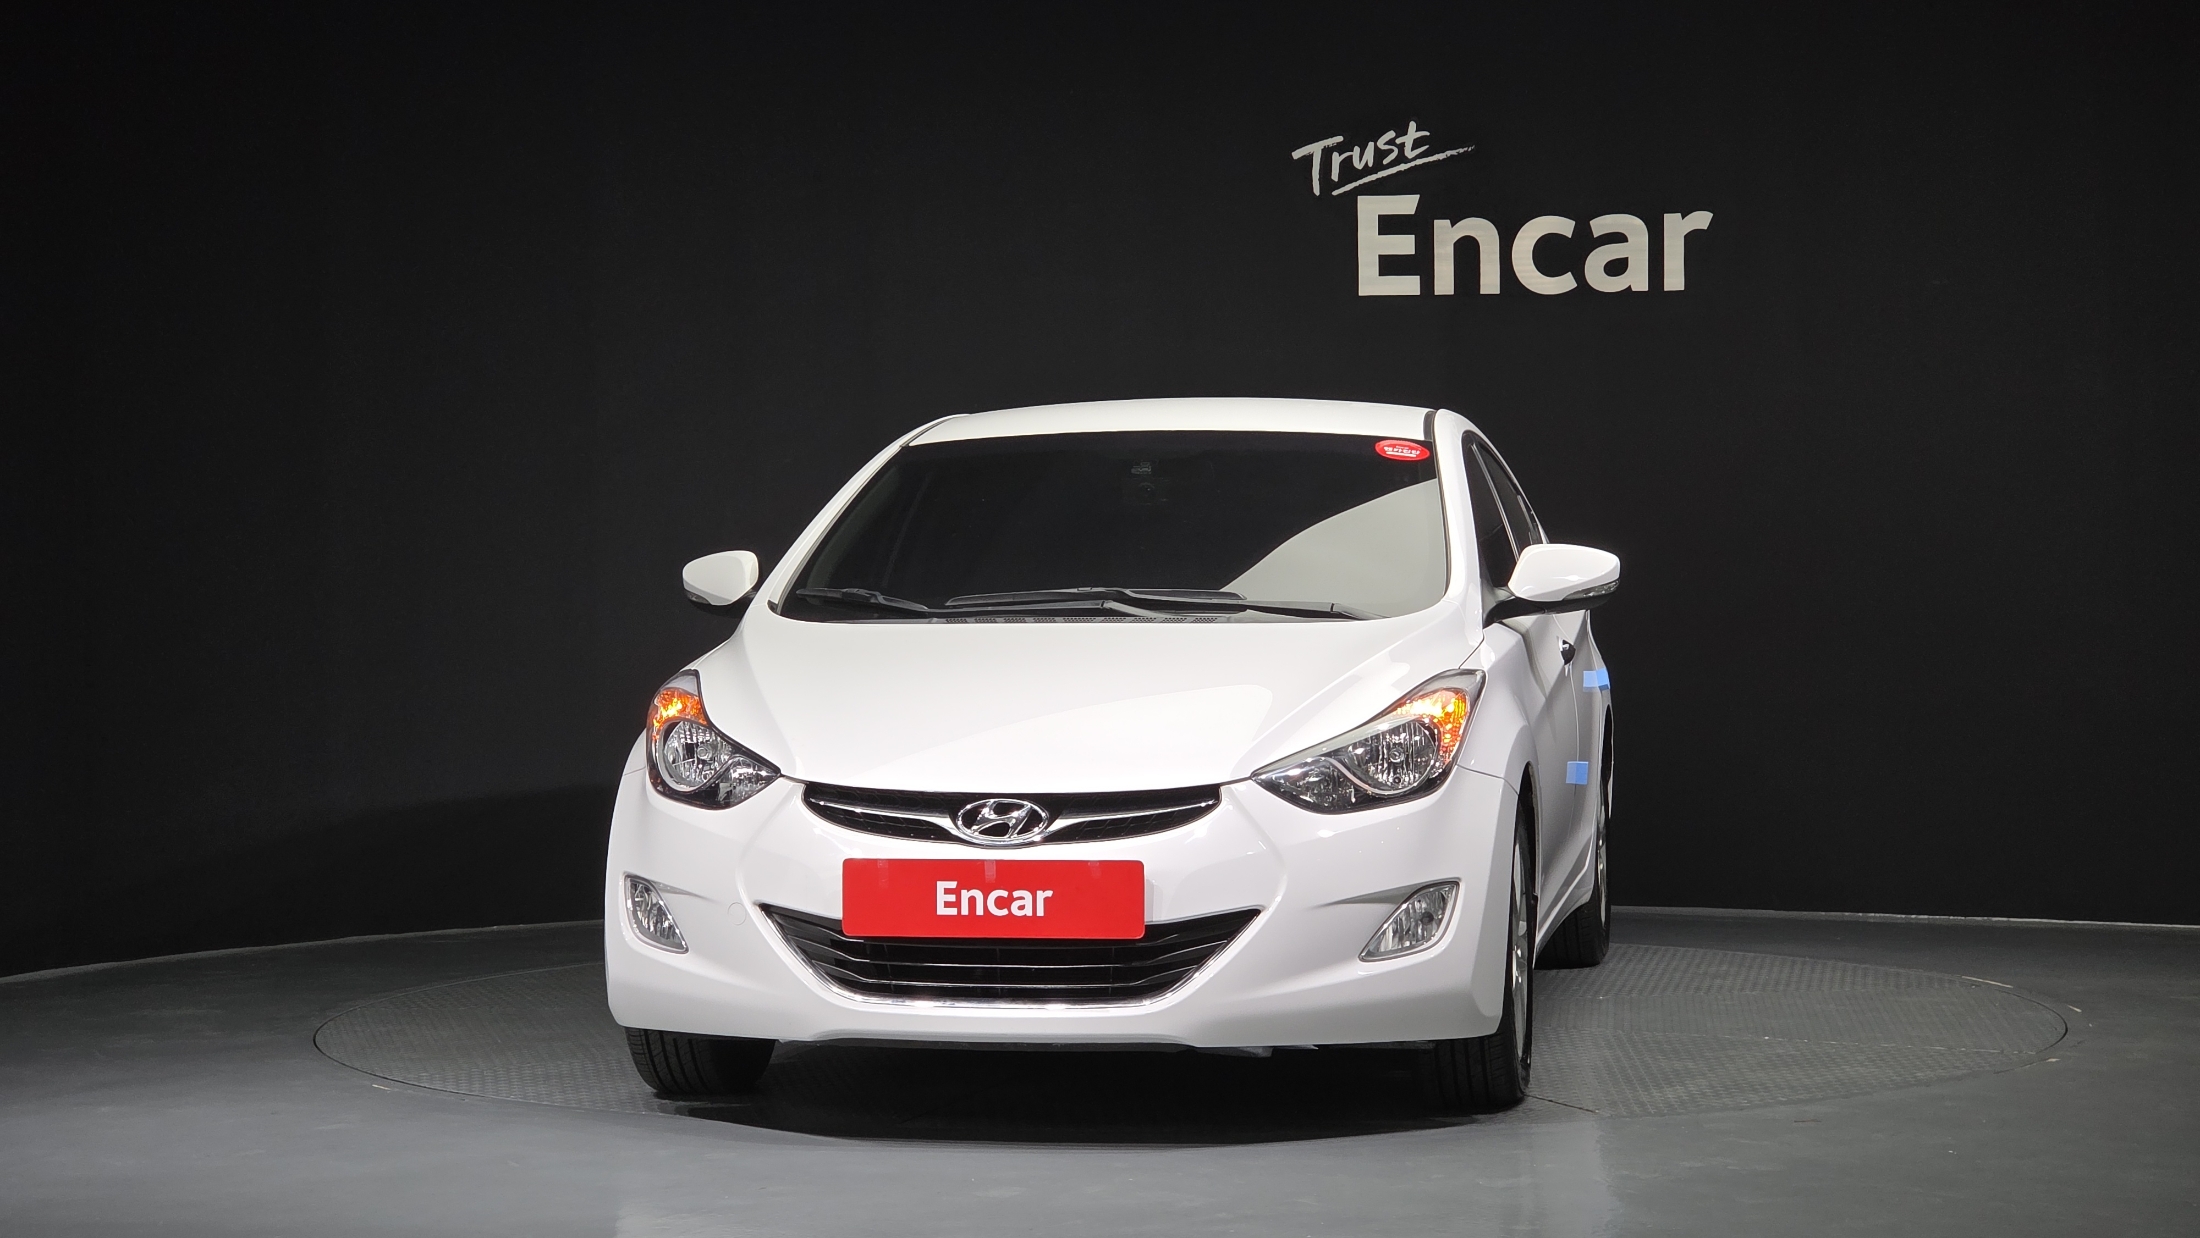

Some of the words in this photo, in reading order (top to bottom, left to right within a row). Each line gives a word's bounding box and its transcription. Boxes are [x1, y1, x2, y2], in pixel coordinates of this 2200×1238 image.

[1291, 120, 1432, 196] Trust
[1356, 193, 1714, 297] Encar
[936, 880, 1054, 917] Encar
